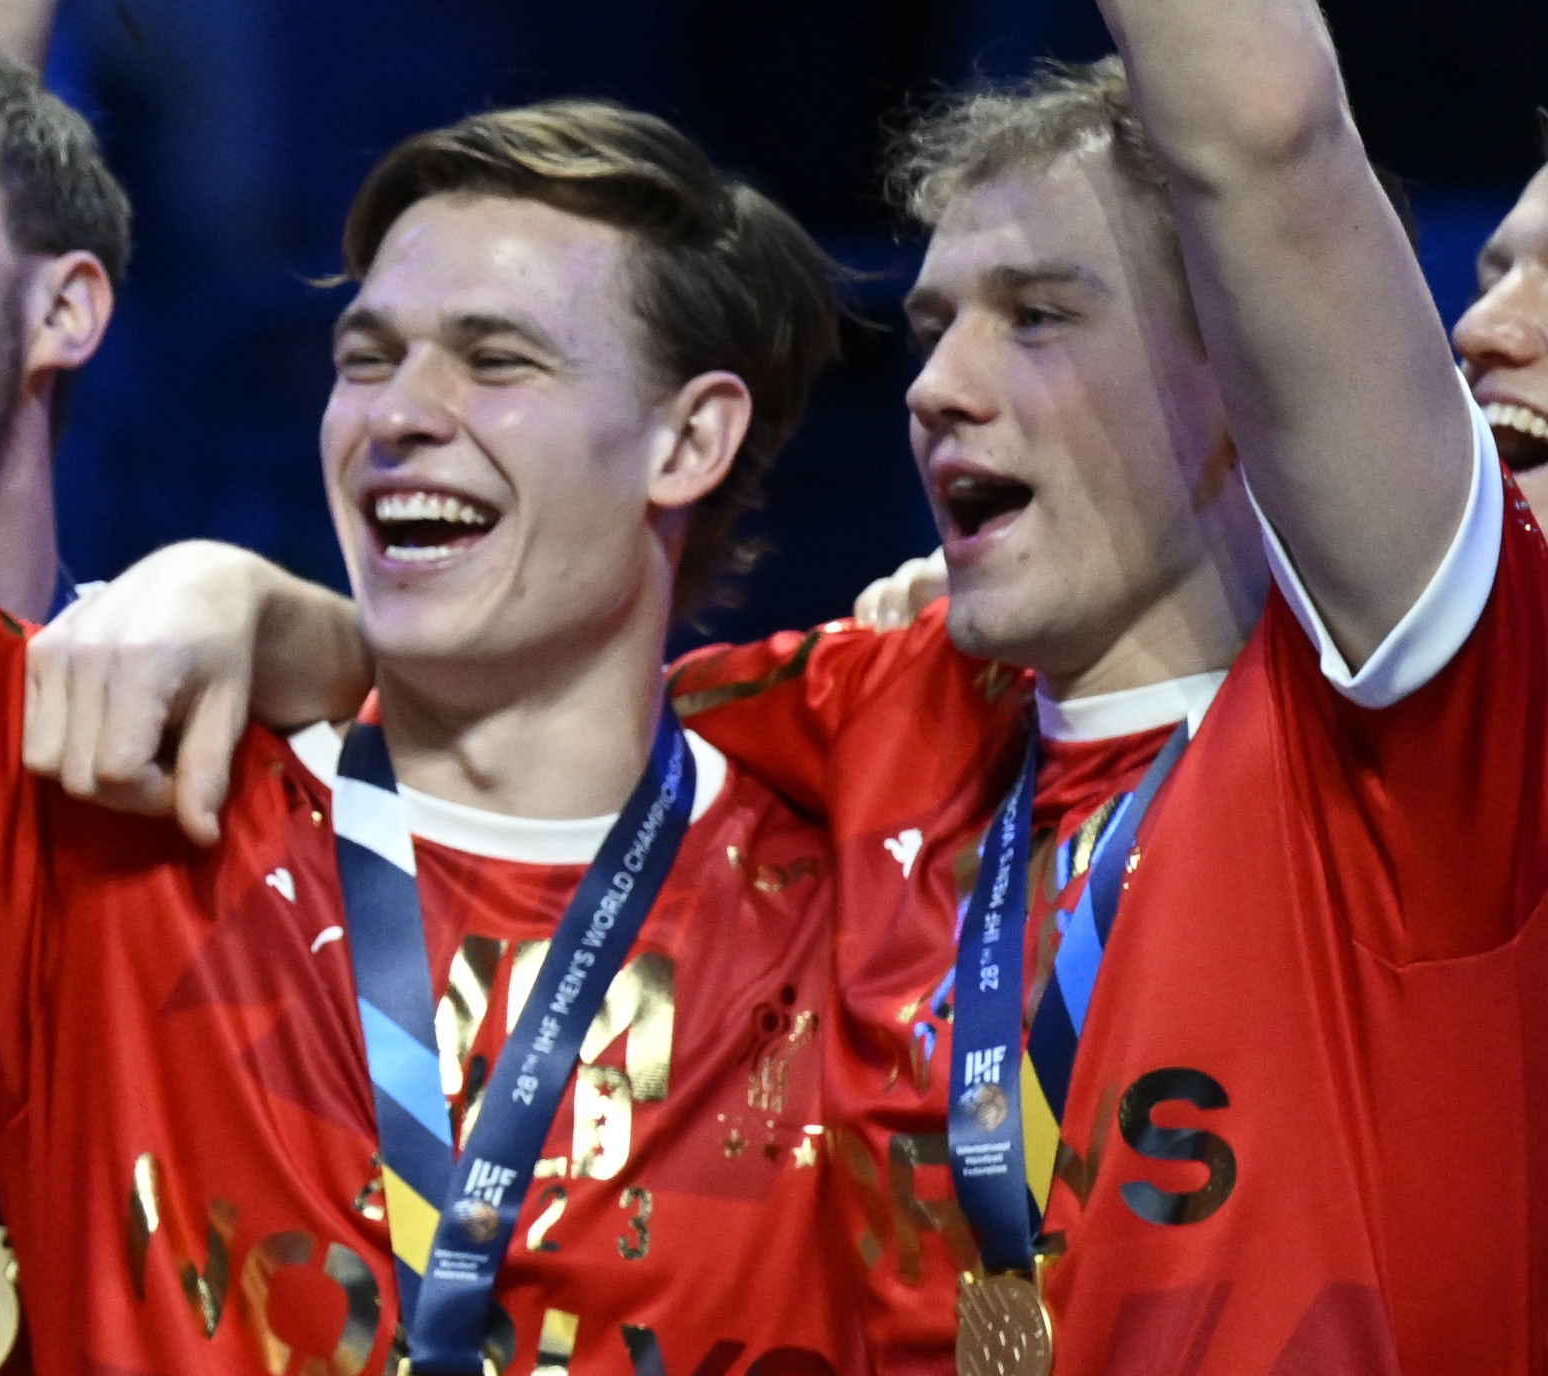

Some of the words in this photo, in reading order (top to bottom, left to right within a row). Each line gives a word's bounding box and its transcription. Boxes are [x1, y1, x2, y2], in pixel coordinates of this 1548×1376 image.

[534, 1013, 561, 1054] IHF
[550, 948, 597, 1015] MEN'S
[581, 870, 636, 948] WORLD
[964, 1045, 1008, 1087] IHF
[463, 1157, 518, 1208] IHF
